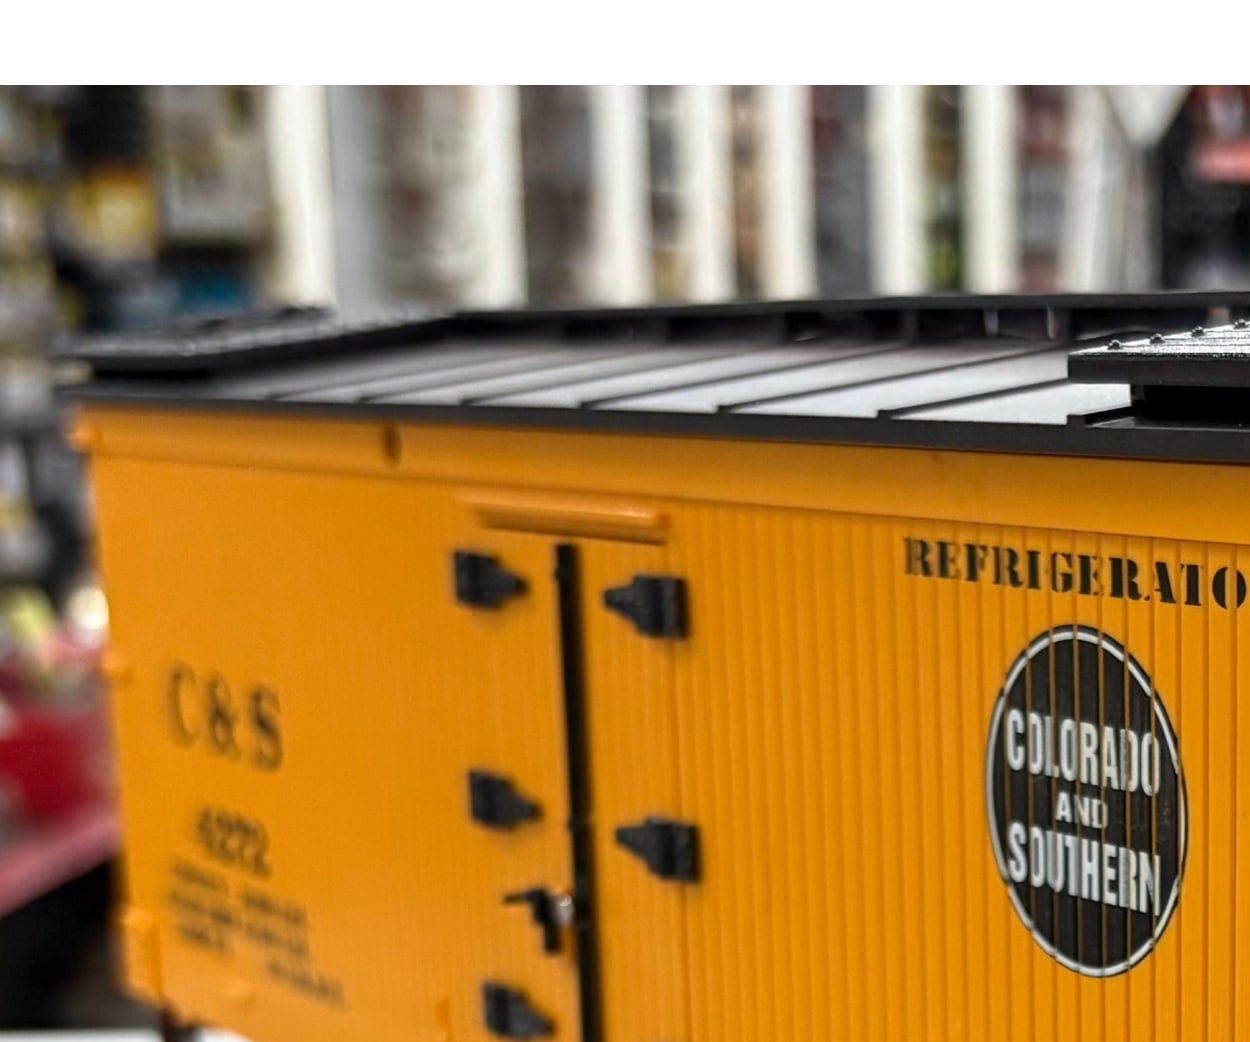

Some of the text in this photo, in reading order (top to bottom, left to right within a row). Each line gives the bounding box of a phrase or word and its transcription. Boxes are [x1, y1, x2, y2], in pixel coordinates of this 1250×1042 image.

[1006, 708, 1161, 798] COLORADO
[1055, 791, 1108, 829] AND
[1007, 822, 1161, 917] SOUTHERN
